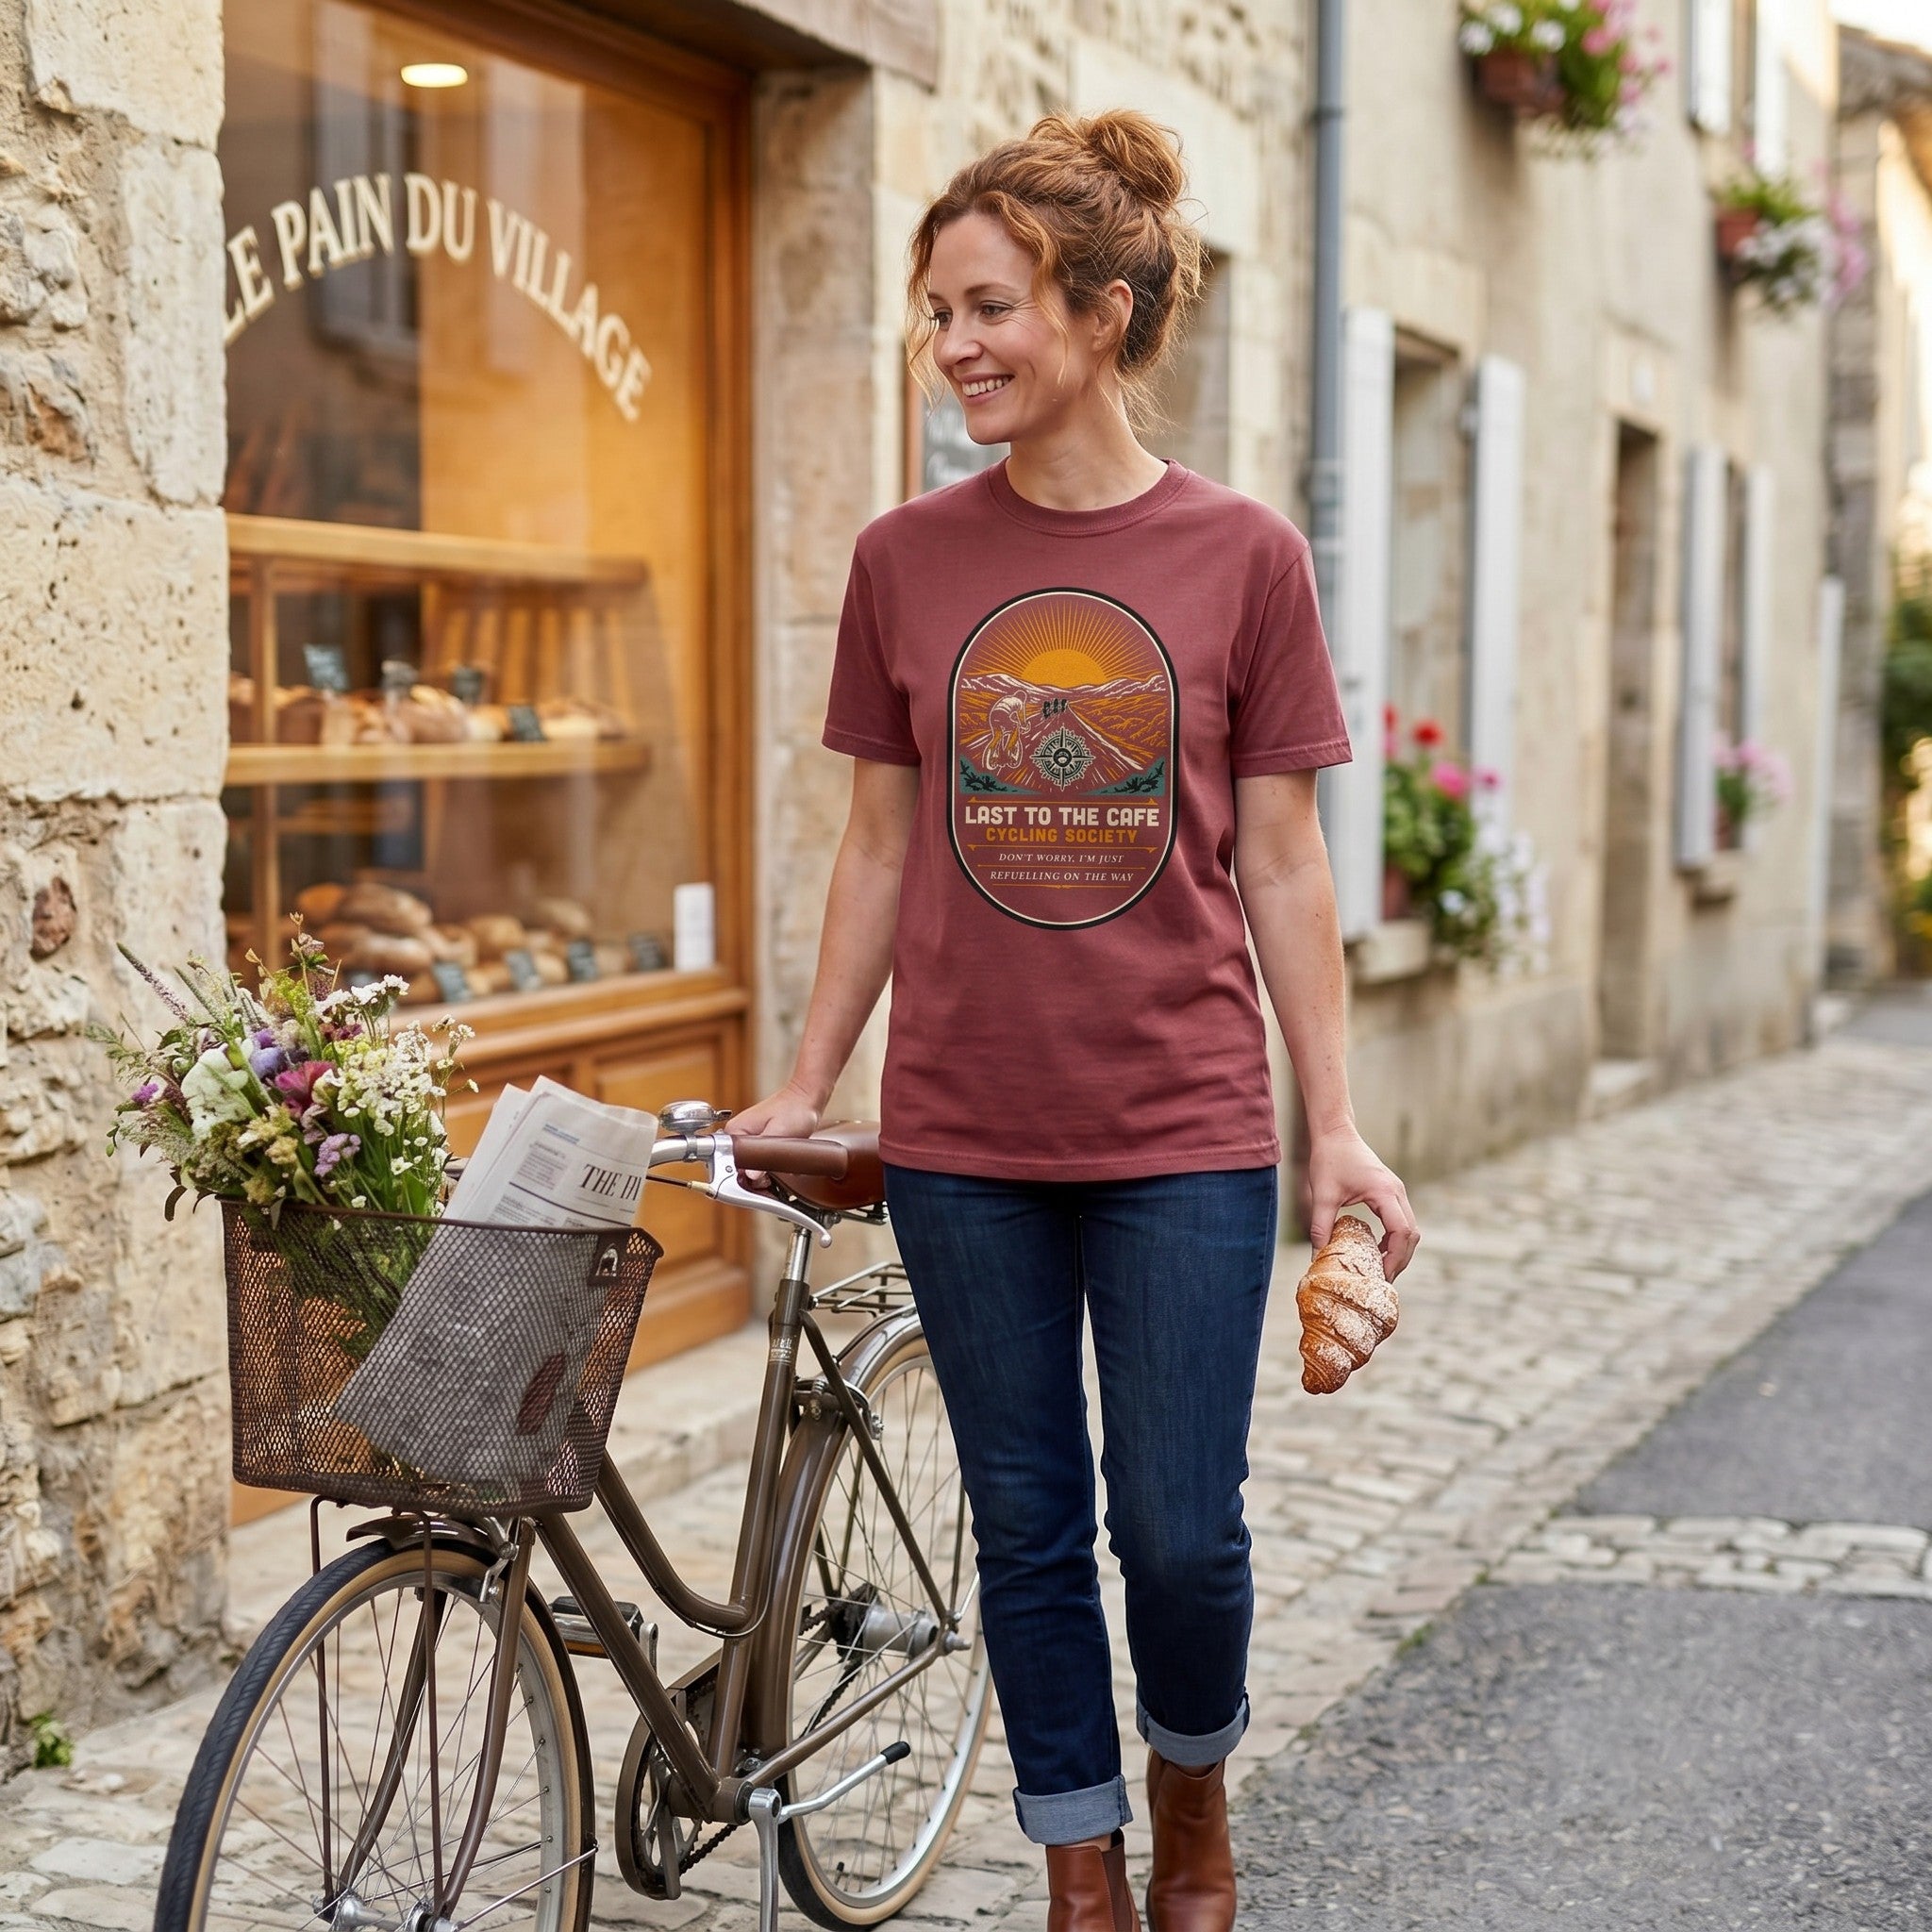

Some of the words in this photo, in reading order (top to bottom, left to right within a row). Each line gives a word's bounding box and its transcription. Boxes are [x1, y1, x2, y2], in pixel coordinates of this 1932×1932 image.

[270, 173, 394, 291] PAIN
[404, 172, 477, 267] DU
[486, 197, 654, 424] VILLAGE
[965, 806, 1018, 825] LAST
[1024, 807, 1052, 825] TO
[1058, 807, 1100, 826] THE
[1106, 808, 1159, 827] CAFE
[986, 827, 1058, 843] CYCLING
[1065, 828, 1138, 843] SOCIETY
[998, 853, 1034, 862] DON'T
[1078, 855, 1096, 863] I'M
[1098, 855, 1124, 865] JUST
[991, 871, 1060, 881] REFUELLING
[1063, 872, 1080, 881] ON
[1085, 873, 1108, 881] THE
[1111, 873, 1134, 882] WAY
[579, 1163, 623, 1197] THE
